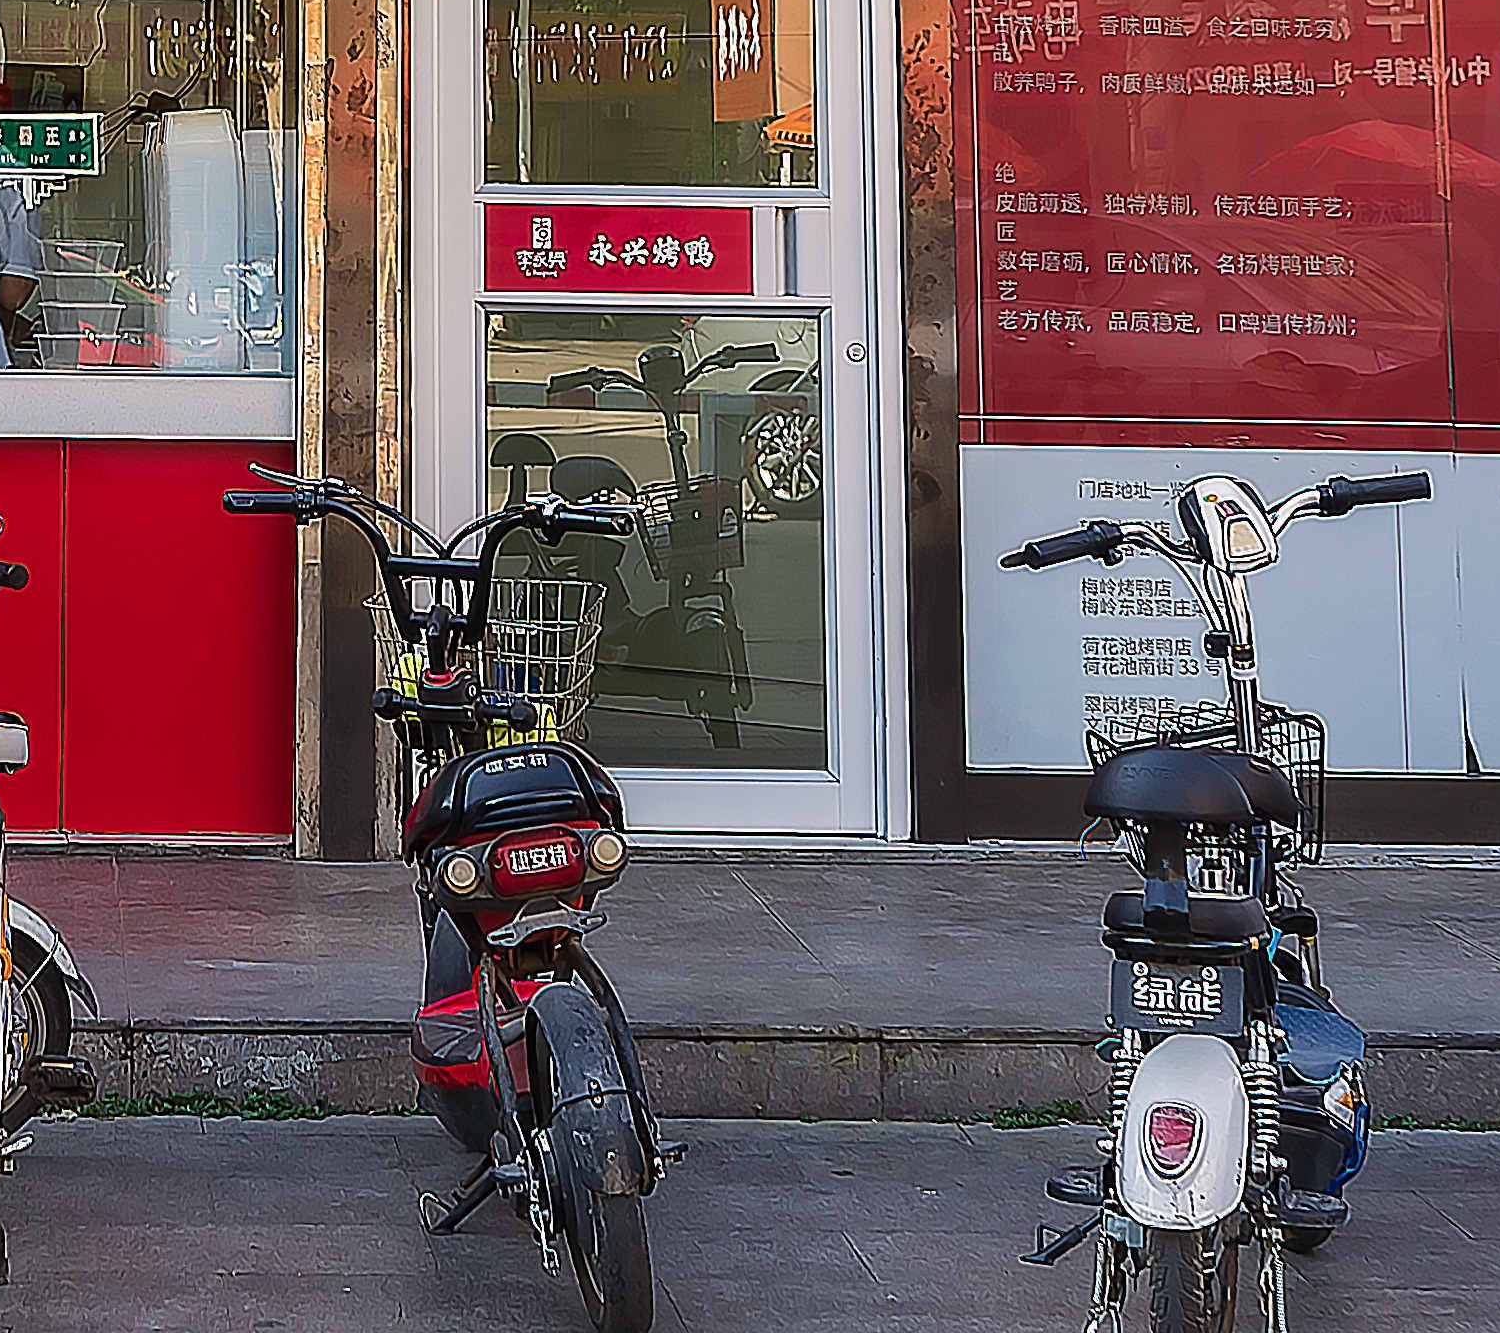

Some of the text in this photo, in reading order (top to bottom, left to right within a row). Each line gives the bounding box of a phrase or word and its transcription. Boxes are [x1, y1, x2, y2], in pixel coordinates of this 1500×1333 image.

[994, 162, 1016, 185] 绝
[996, 221, 1017, 243] 匠
[588, 231, 715, 271] 永兴烤鸭
[997, 279, 1018, 302] 艺
[1081, 577, 1173, 599] 梅岭烤鸭店
[1081, 636, 1193, 657] 荷花池烤鸭店
[1082, 657, 1175, 677] 荷花池南街
[1179, 659, 1200, 676] 33
[1132, 975, 1224, 1014] 绿能
